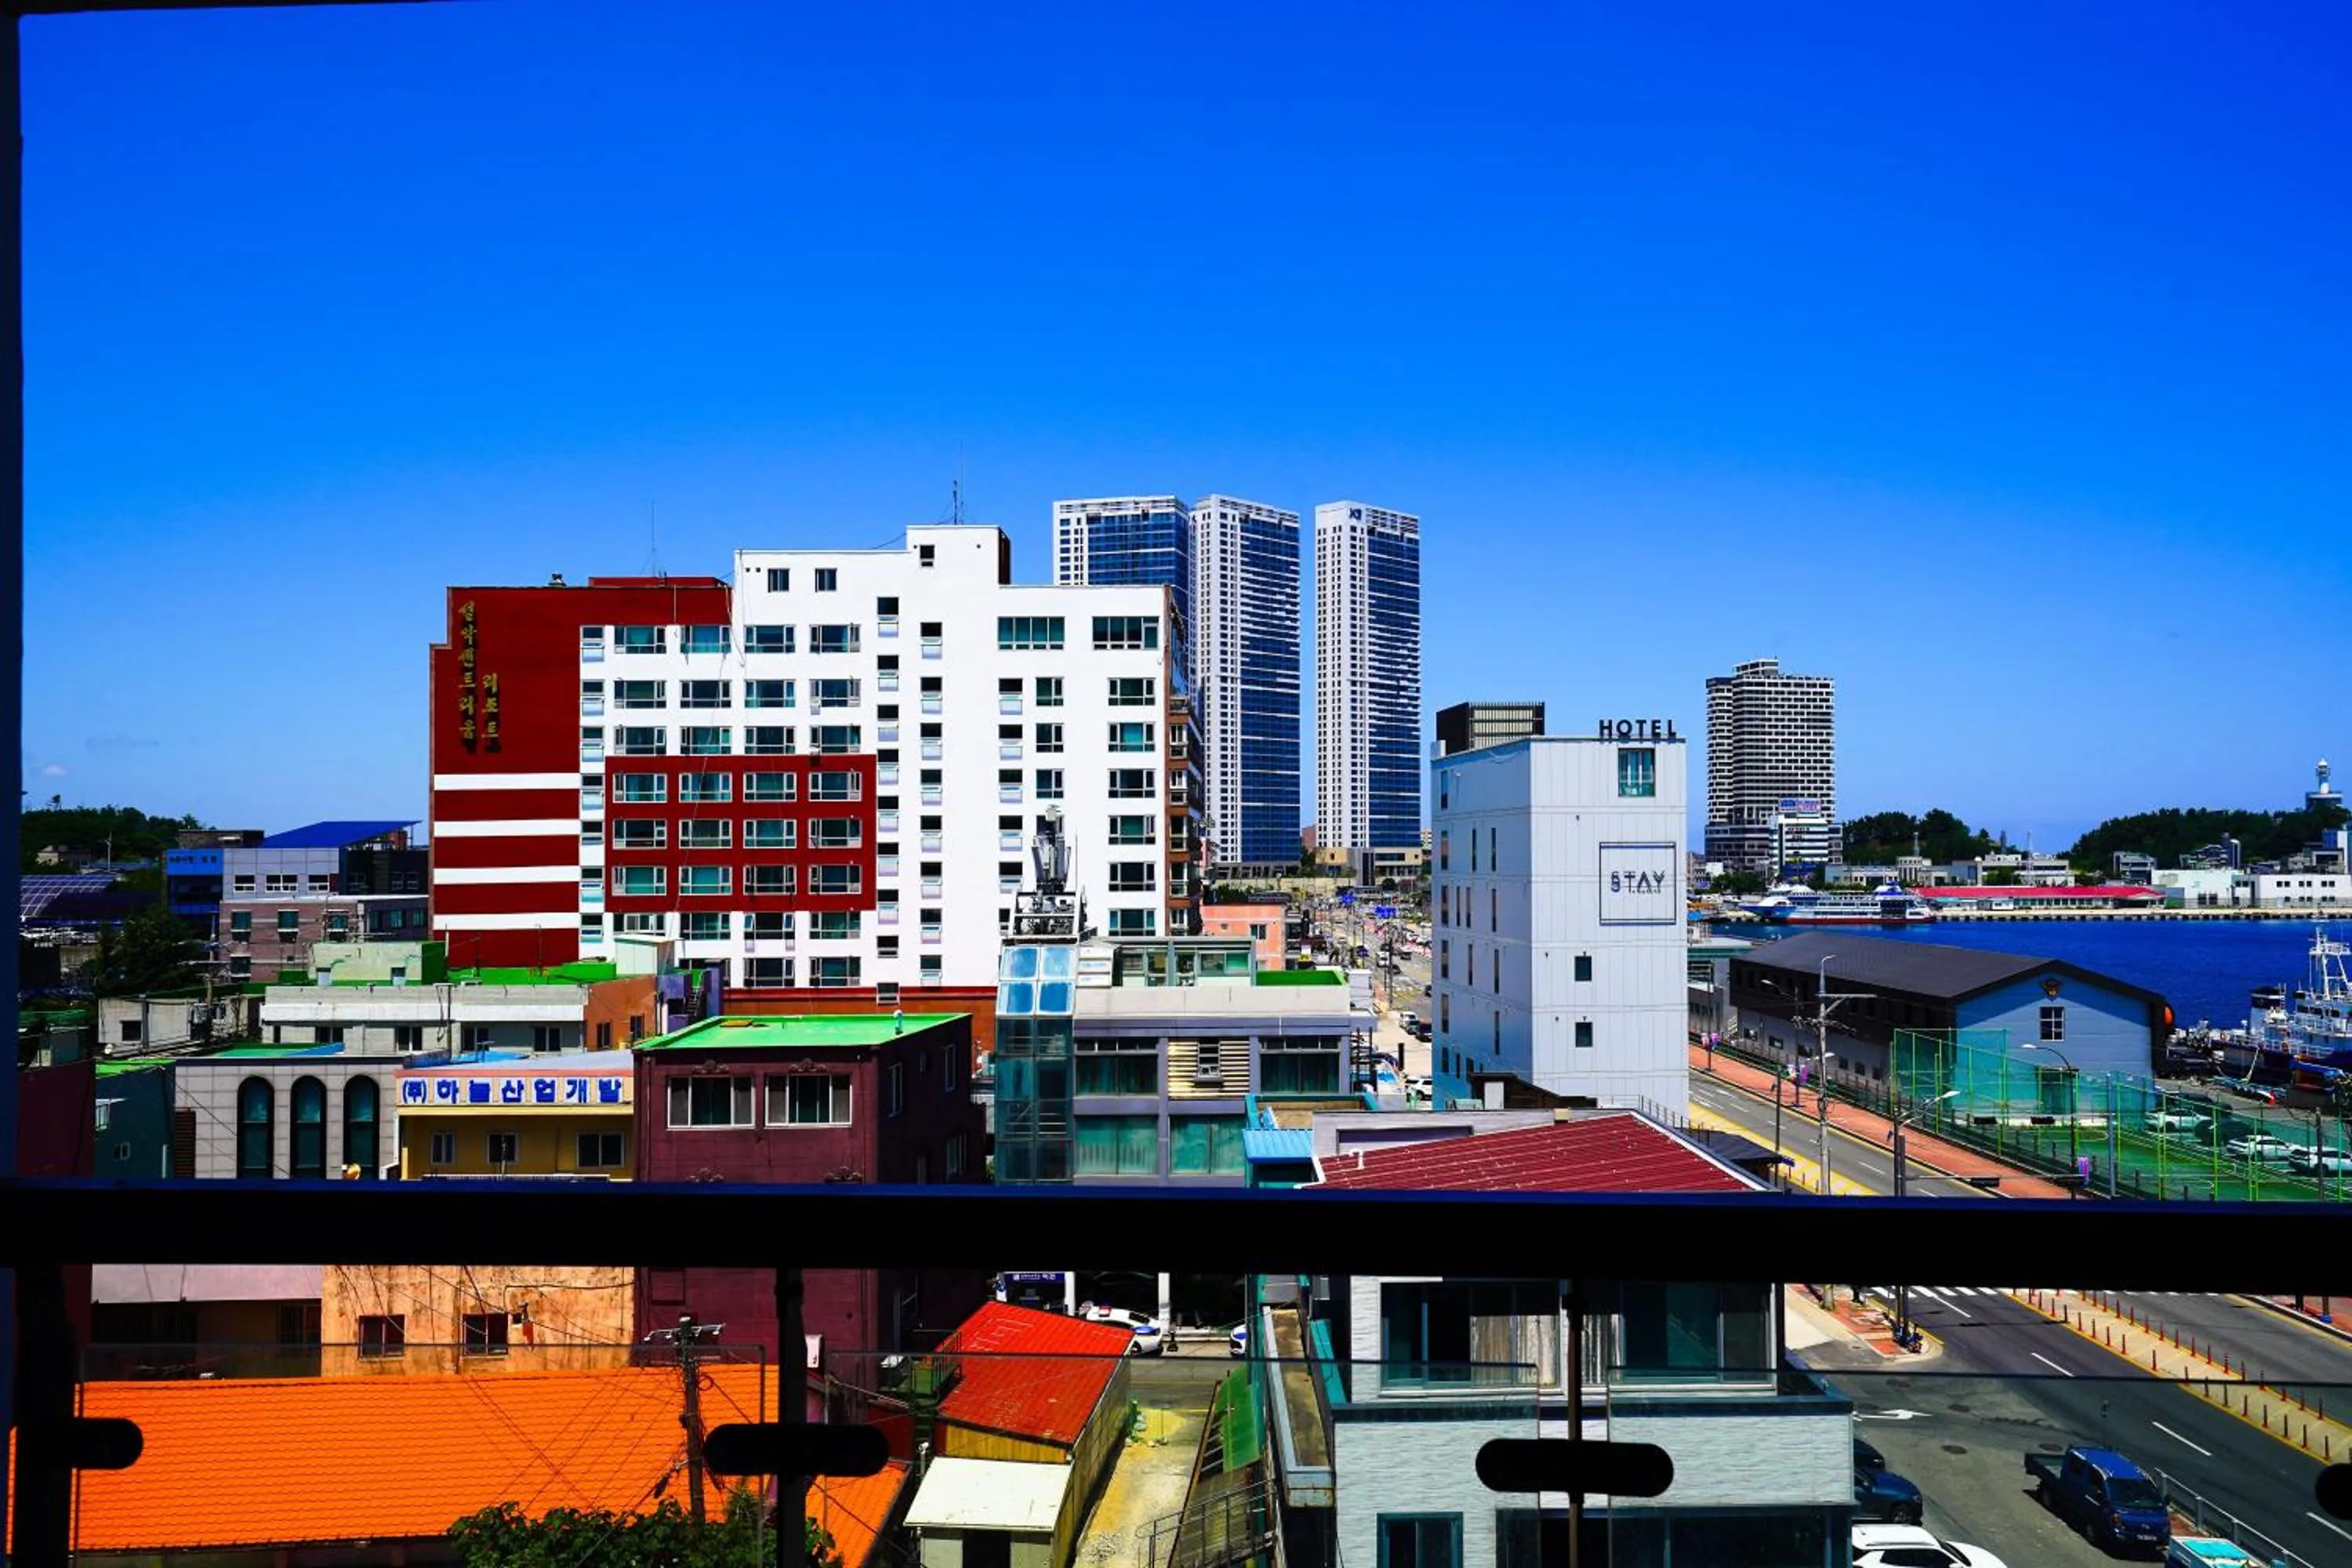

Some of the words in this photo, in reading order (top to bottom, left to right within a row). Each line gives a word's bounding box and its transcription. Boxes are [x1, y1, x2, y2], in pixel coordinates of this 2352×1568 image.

[481, 673, 499, 738] 리조트
[1599, 719, 1677, 739] HOTEL
[1611, 870, 1665, 894] STAY
